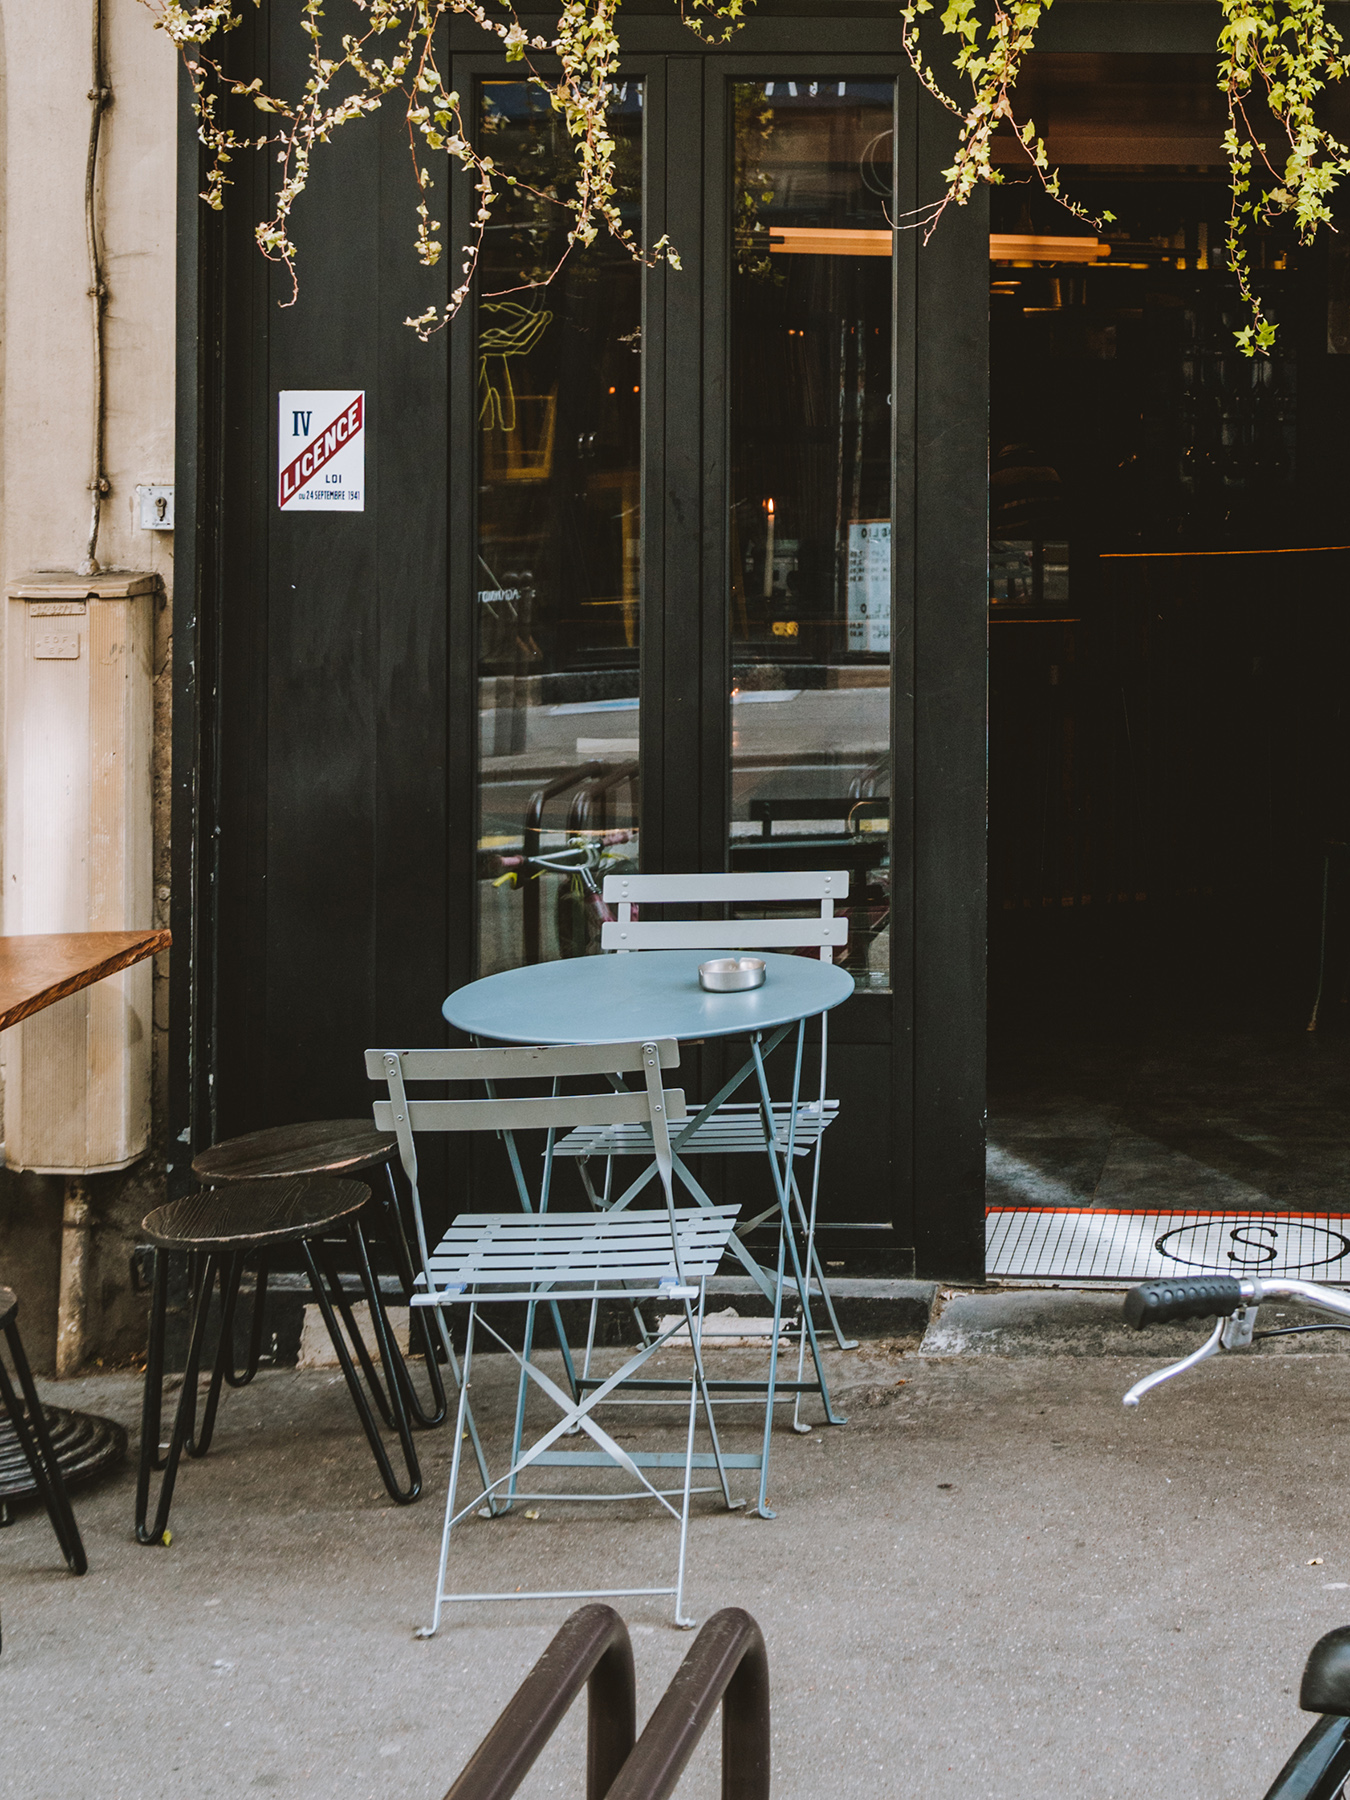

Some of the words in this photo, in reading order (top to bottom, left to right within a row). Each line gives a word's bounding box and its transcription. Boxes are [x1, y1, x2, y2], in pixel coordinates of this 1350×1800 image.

[292, 411, 313, 436] IV
[282, 402, 361, 500] LICENCE
[325, 474, 343, 484] LOI
[306, 490, 314, 500] 24
[314, 490, 346, 501] SEPTEMBRE
[347, 490, 361, 501] 1941
[1226, 1226, 1279, 1264] S
